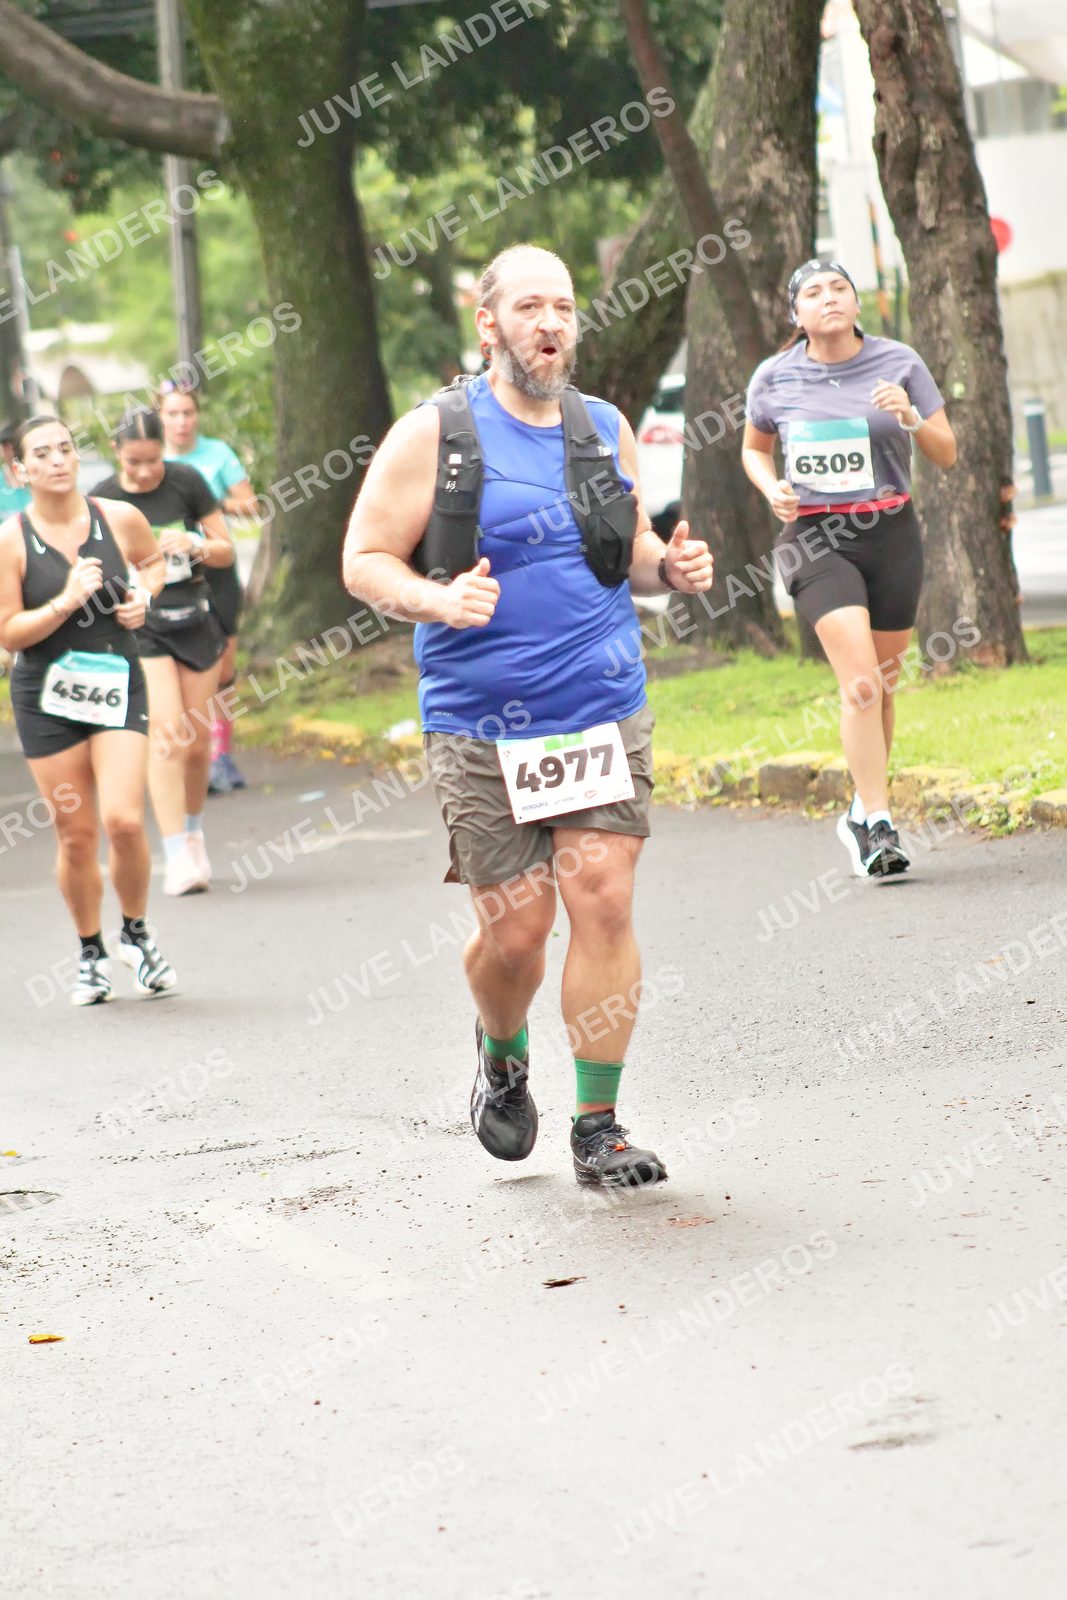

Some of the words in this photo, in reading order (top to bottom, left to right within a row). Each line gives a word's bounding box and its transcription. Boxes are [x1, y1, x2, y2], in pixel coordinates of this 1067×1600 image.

[795, 452, 865, 475] 6309
[51, 680, 122, 708] 4546
[515, 743, 614, 793] 4977
